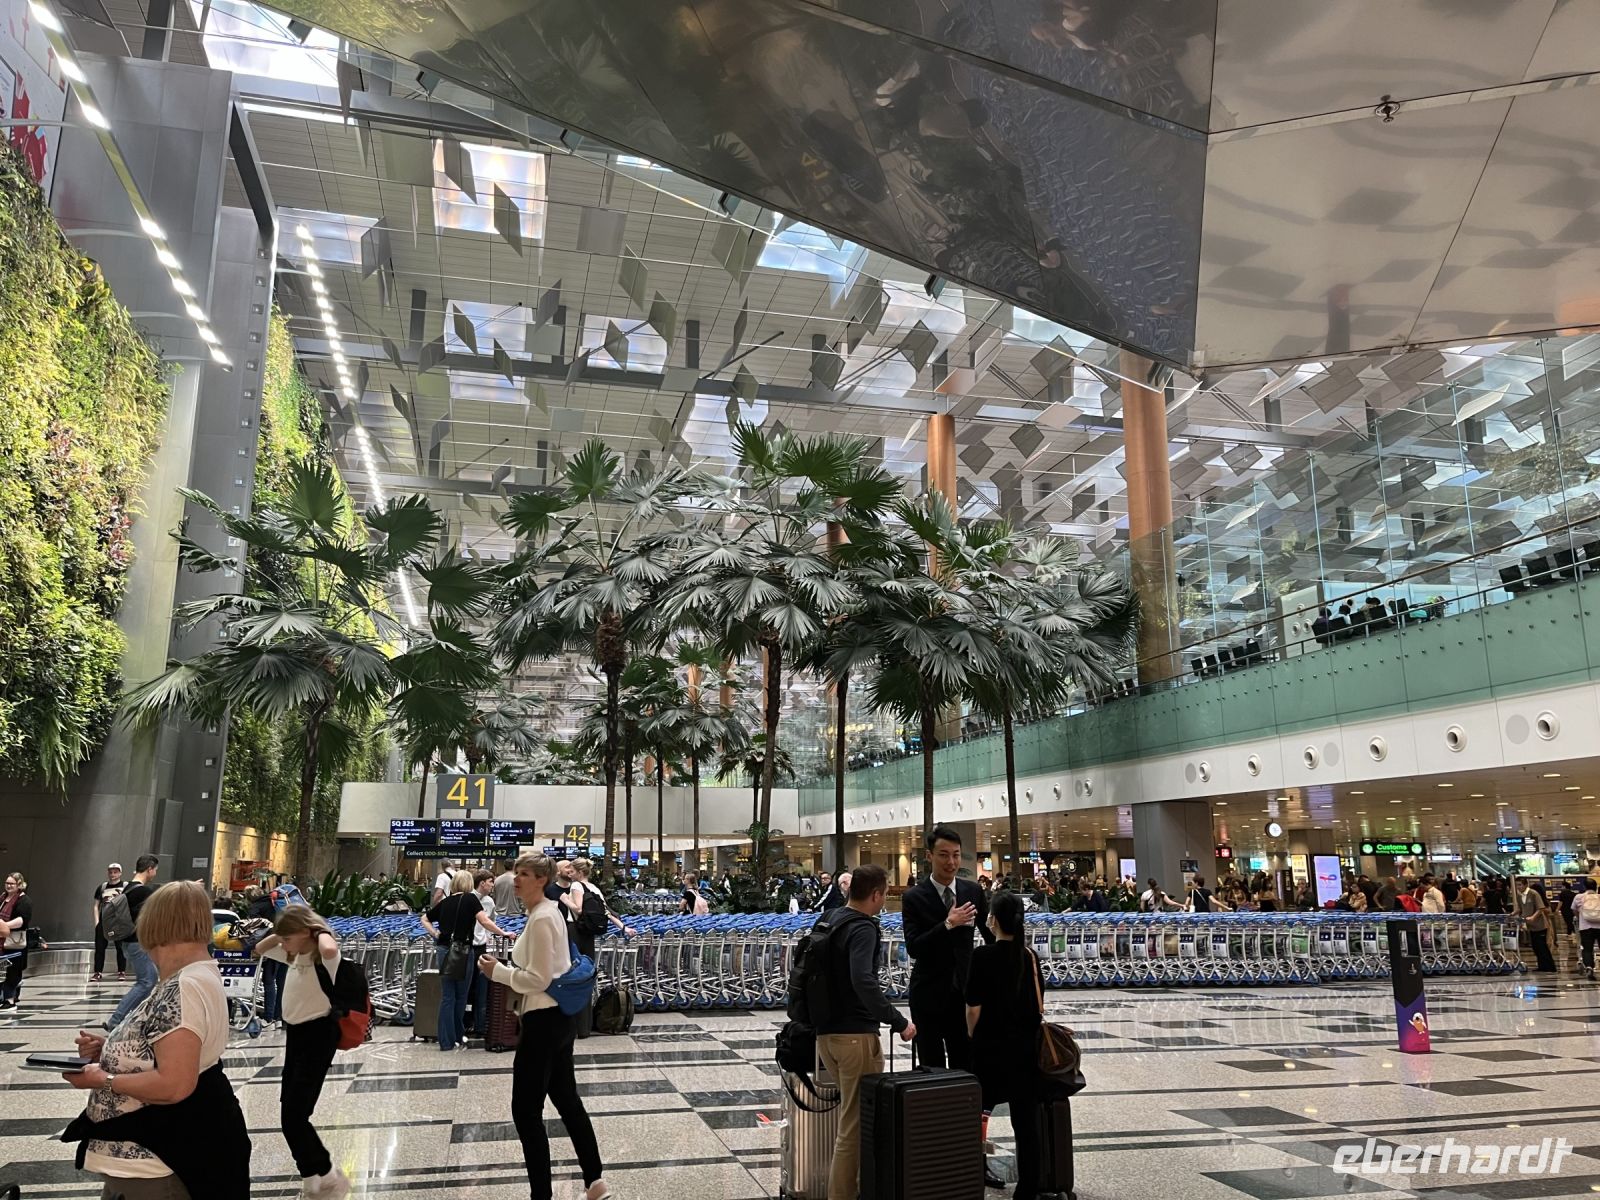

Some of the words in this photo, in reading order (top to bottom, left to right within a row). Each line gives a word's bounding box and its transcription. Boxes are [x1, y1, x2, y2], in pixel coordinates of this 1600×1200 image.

[446, 777, 487, 807] 41
[391, 820, 401, 828] SQ
[567, 826, 588, 841] 42
